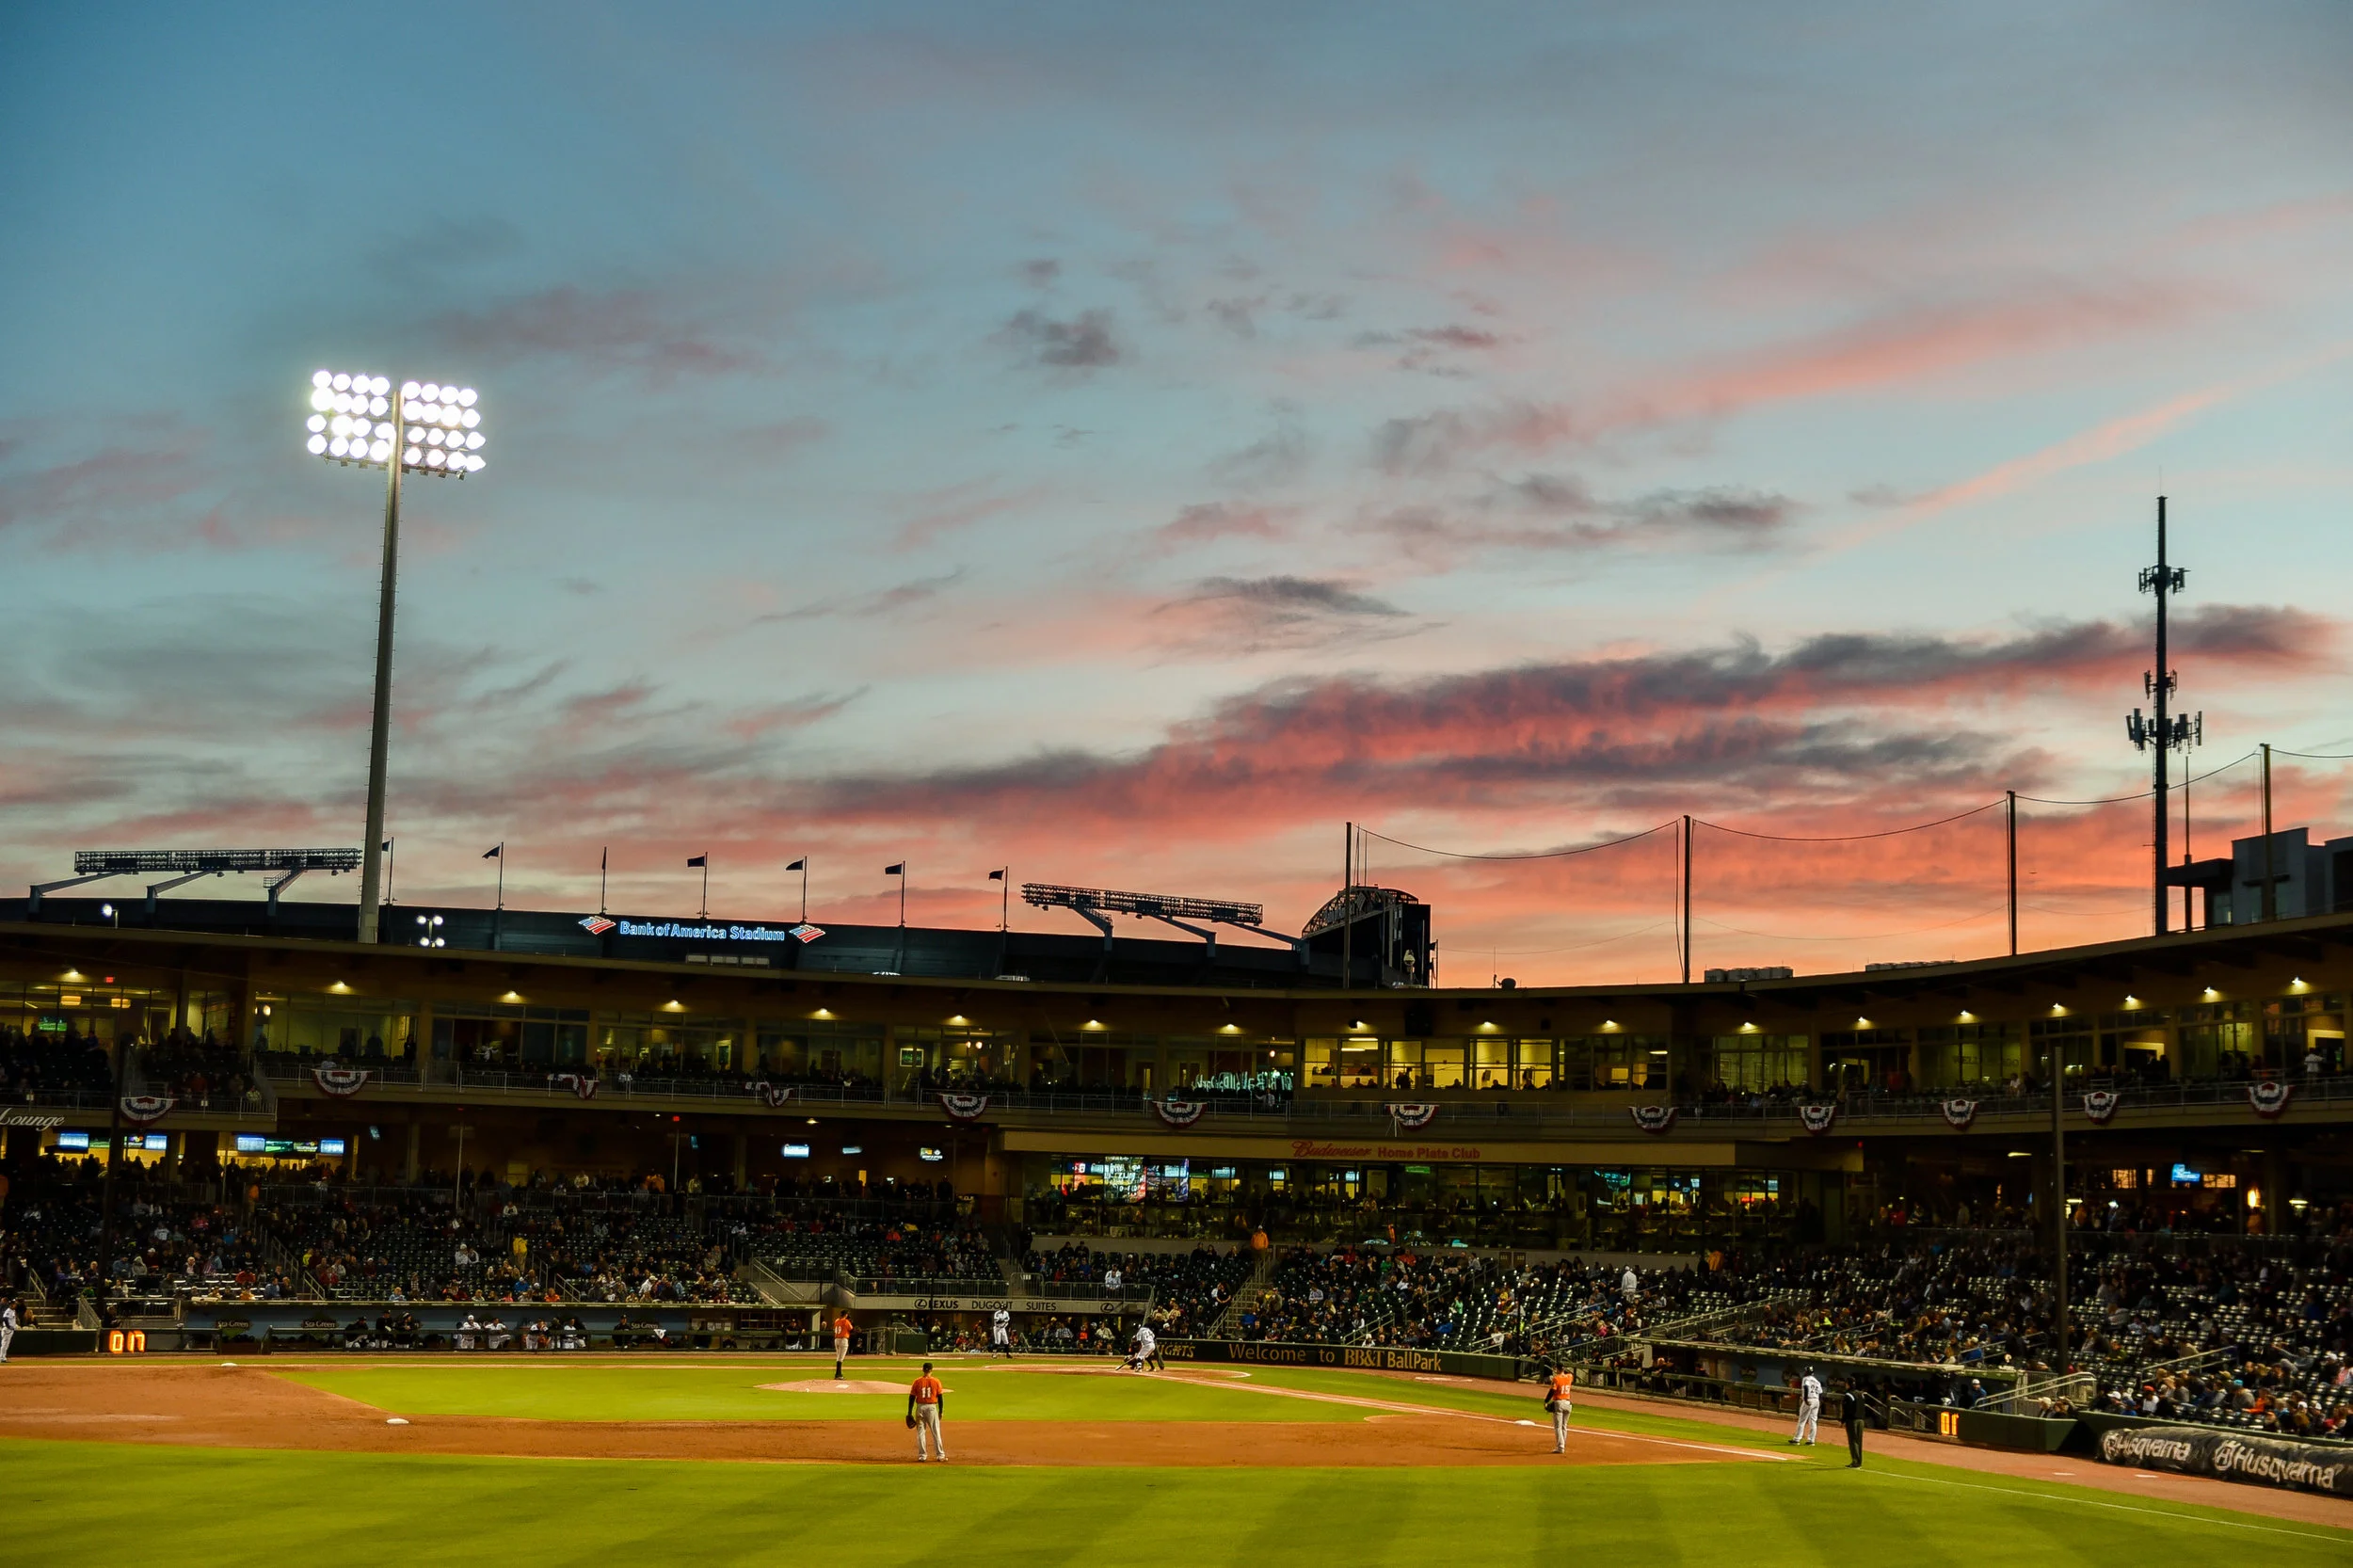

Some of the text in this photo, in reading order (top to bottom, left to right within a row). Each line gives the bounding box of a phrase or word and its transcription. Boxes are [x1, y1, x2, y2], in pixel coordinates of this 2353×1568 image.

[619, 920, 785, 941] Bank of America Stadium
[0, 1107, 65, 1131] Lounge
[1291, 1141, 1481, 1160] Budweiser Home Plate Club
[1026, 1302, 1057, 1311] SUITES
[1229, 1343, 1306, 1362] Welcome
[1319, 1349, 1335, 1363] to
[1344, 1348, 1385, 1367] BB&T
[1387, 1351, 1442, 1371] BallPark
[920, 1386, 931, 1399] 11
[2117, 1434, 2191, 1461] Husqvarna
[2233, 1447, 2334, 1489] Husqvarna
